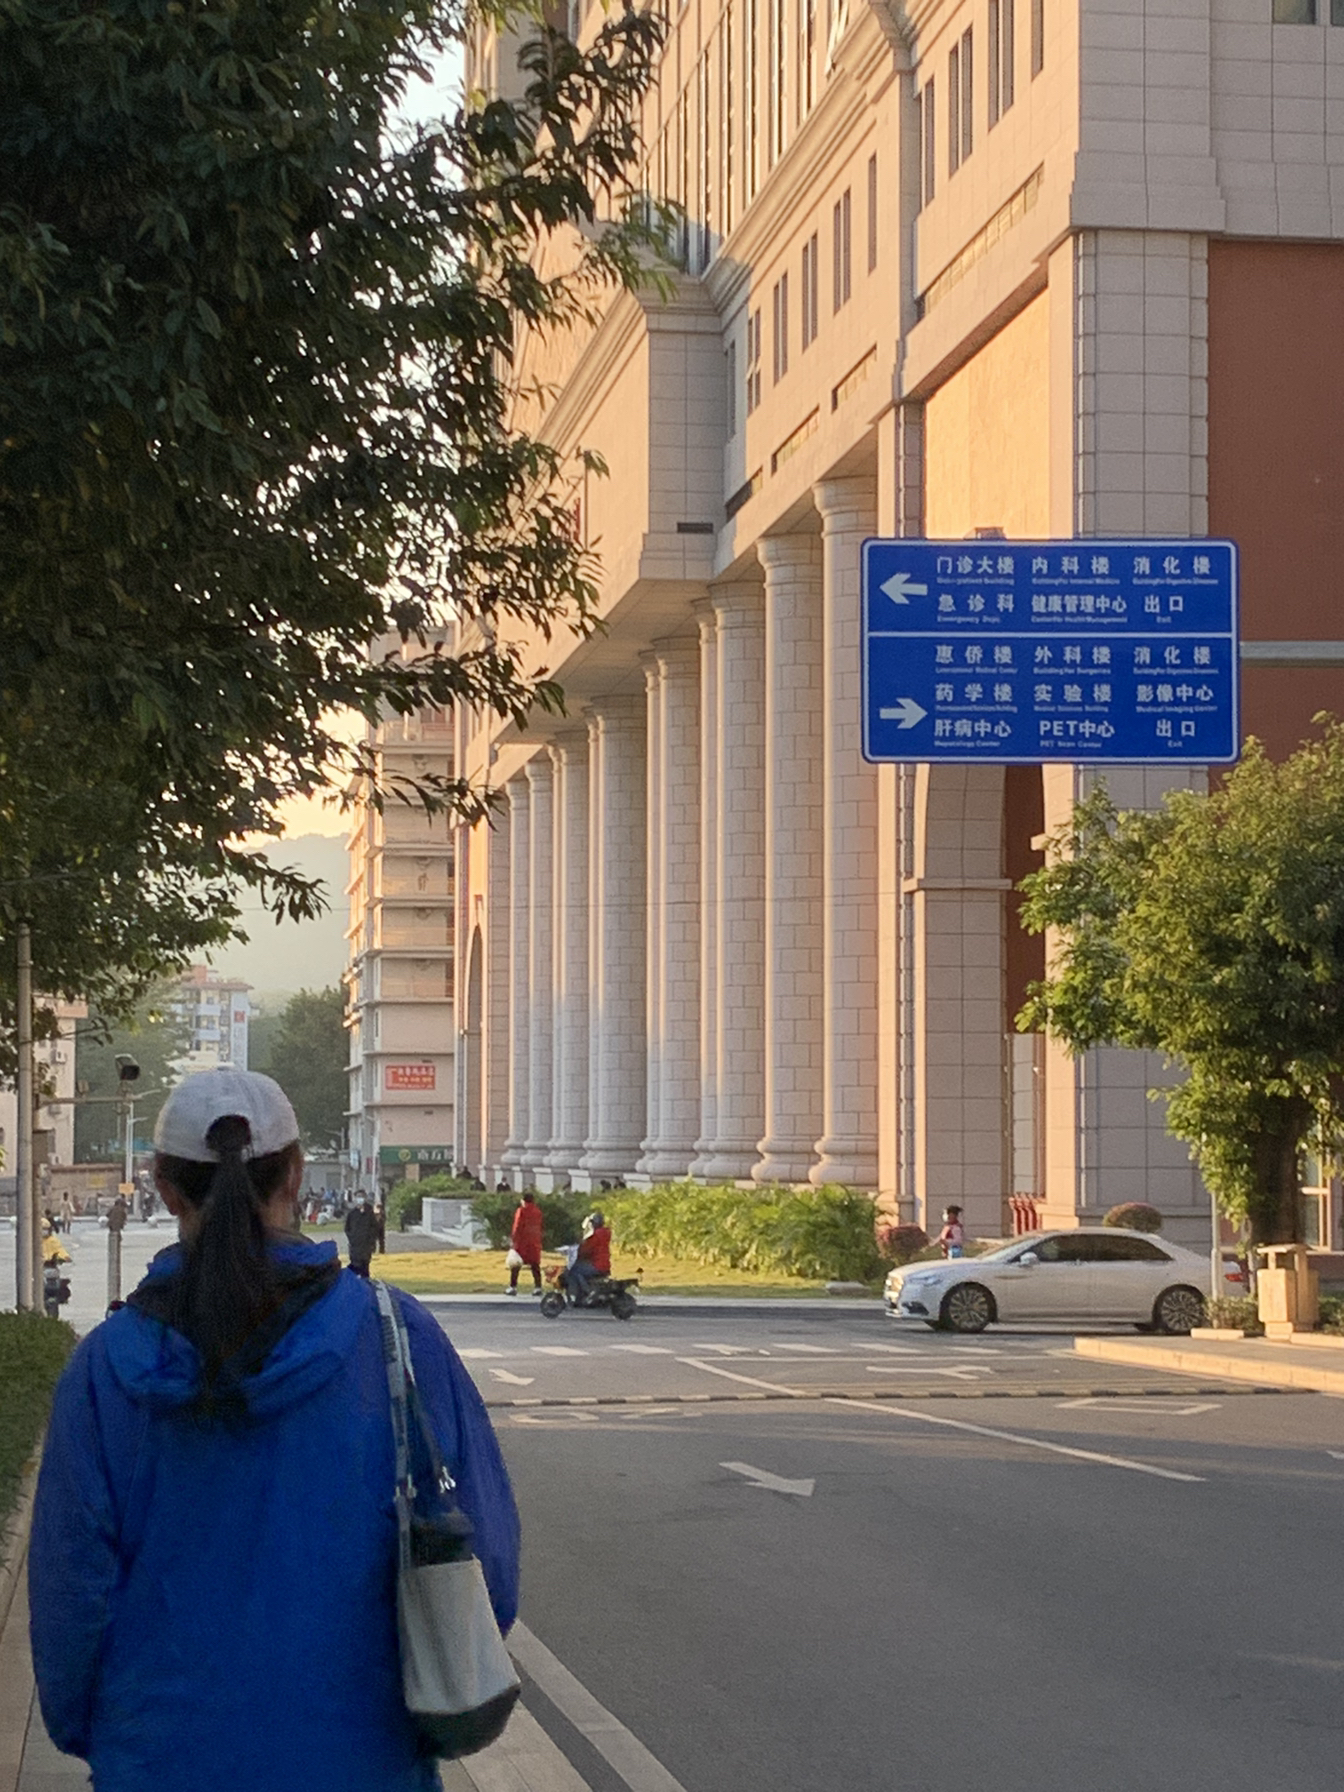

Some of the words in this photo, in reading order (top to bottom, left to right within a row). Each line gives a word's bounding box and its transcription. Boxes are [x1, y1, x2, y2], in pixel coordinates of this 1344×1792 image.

[937, 556, 1014, 574] 门诊大楼
[1032, 556, 1109, 574] 内科楼
[1133, 556, 1210, 574] 消化楼
[938, 593, 1014, 612] 急诊科
[1031, 594, 1127, 613] 健康管理中心
[1144, 595, 1183, 613] 出口
[935, 645, 1013, 664] 惠侨楼
[1034, 646, 1111, 664] 外科楼
[1133, 646, 1211, 664] 消化楼
[935, 683, 1012, 702] 药学楼
[1034, 684, 1112, 702] 实验楼
[1136, 685, 1213, 702] 影像中心
[934, 719, 1012, 737] 肝病中心
[1039, 719, 1115, 738] PET中心
[1156, 719, 1195, 737] 出口
